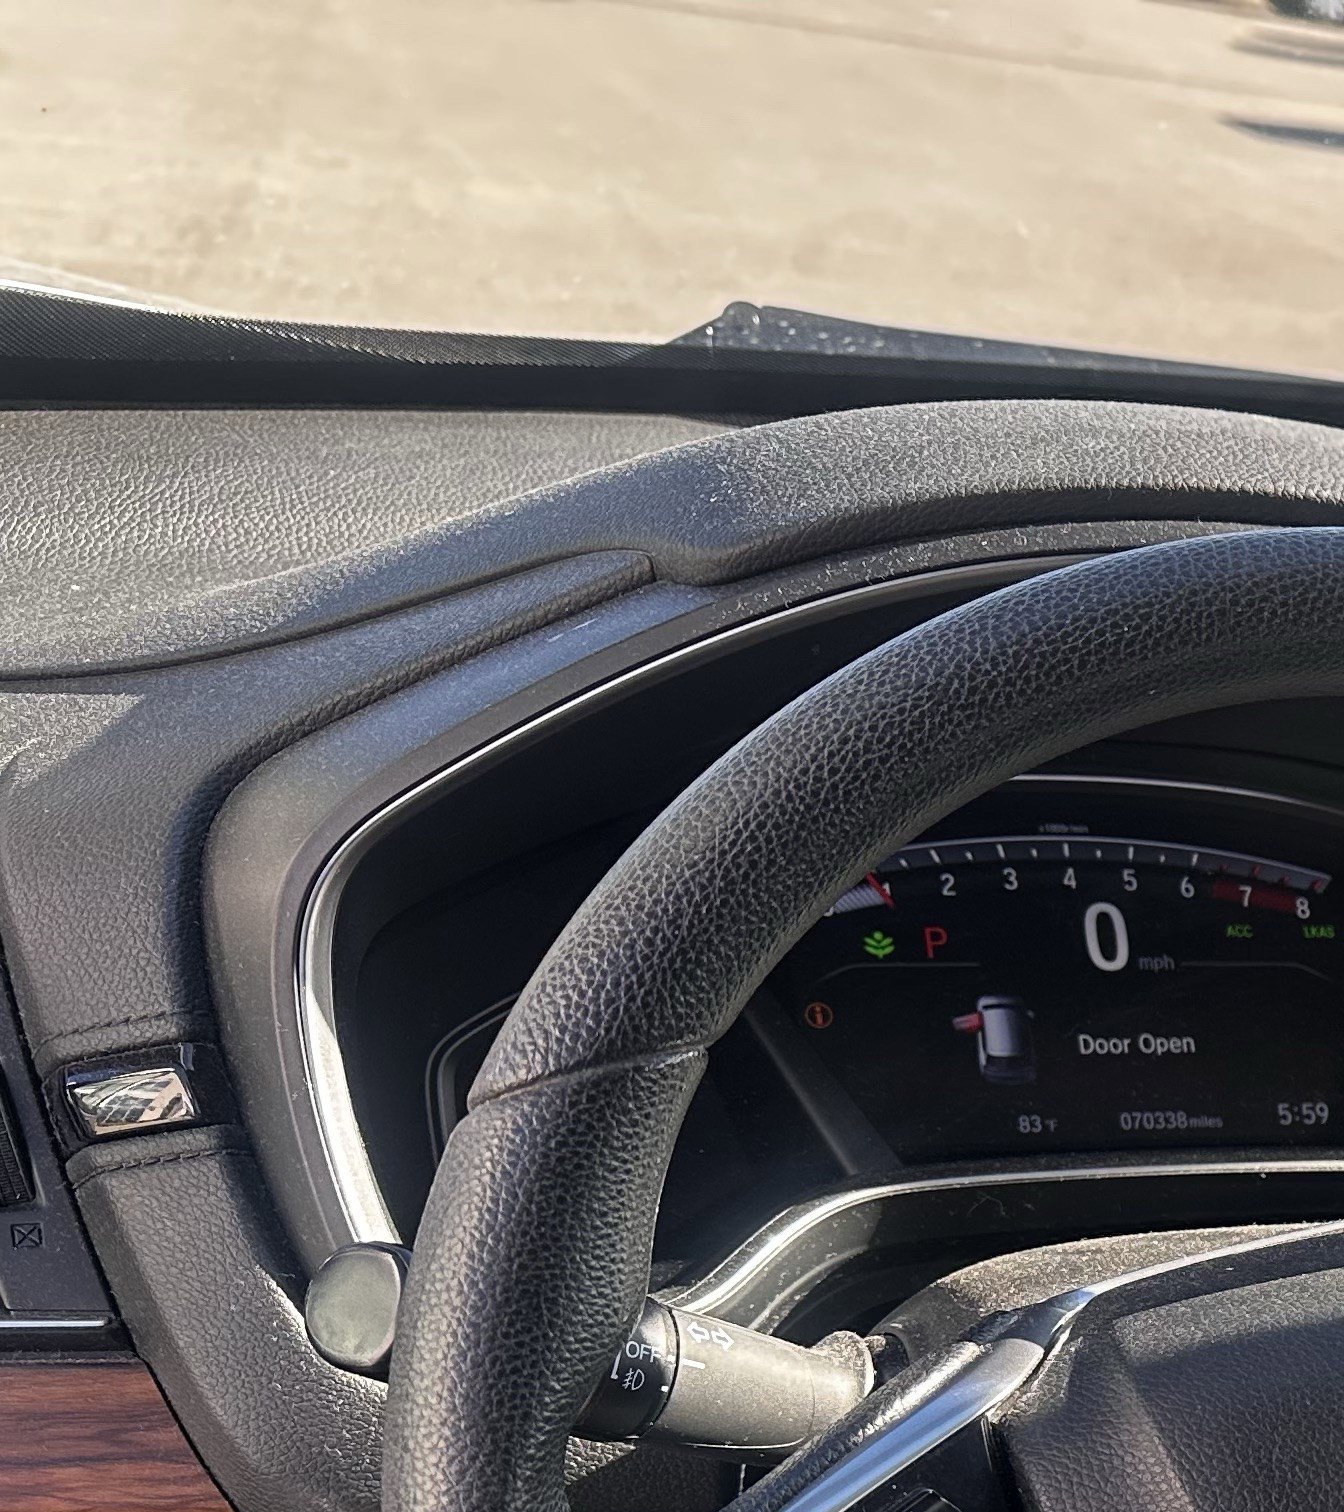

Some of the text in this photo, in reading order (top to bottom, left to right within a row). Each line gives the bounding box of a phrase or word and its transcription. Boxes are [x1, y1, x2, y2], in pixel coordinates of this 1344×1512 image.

[940, 873, 956, 896] 2
[1003, 867, 1018, 890] 3
[1063, 867, 1076, 889] 4
[1122, 868, 1138, 891] 5
[1180, 876, 1195, 898] 6
[1239, 885, 1252, 907] 7
[1295, 896, 1310, 919] 8
[1084, 901, 1129, 971] 0
[1226, 923, 1253, 938] ACC
[924, 927, 947, 958] P
[1138, 954, 1174, 972] mph
[1078, 1032, 1195, 1056] Door Open
[1017, 1114, 1042, 1133] 83
[1119, 1110, 1188, 1131] 070338
[1277, 1101, 1329, 1126] 5:59
[625, 1341, 662, 1364] OFF
